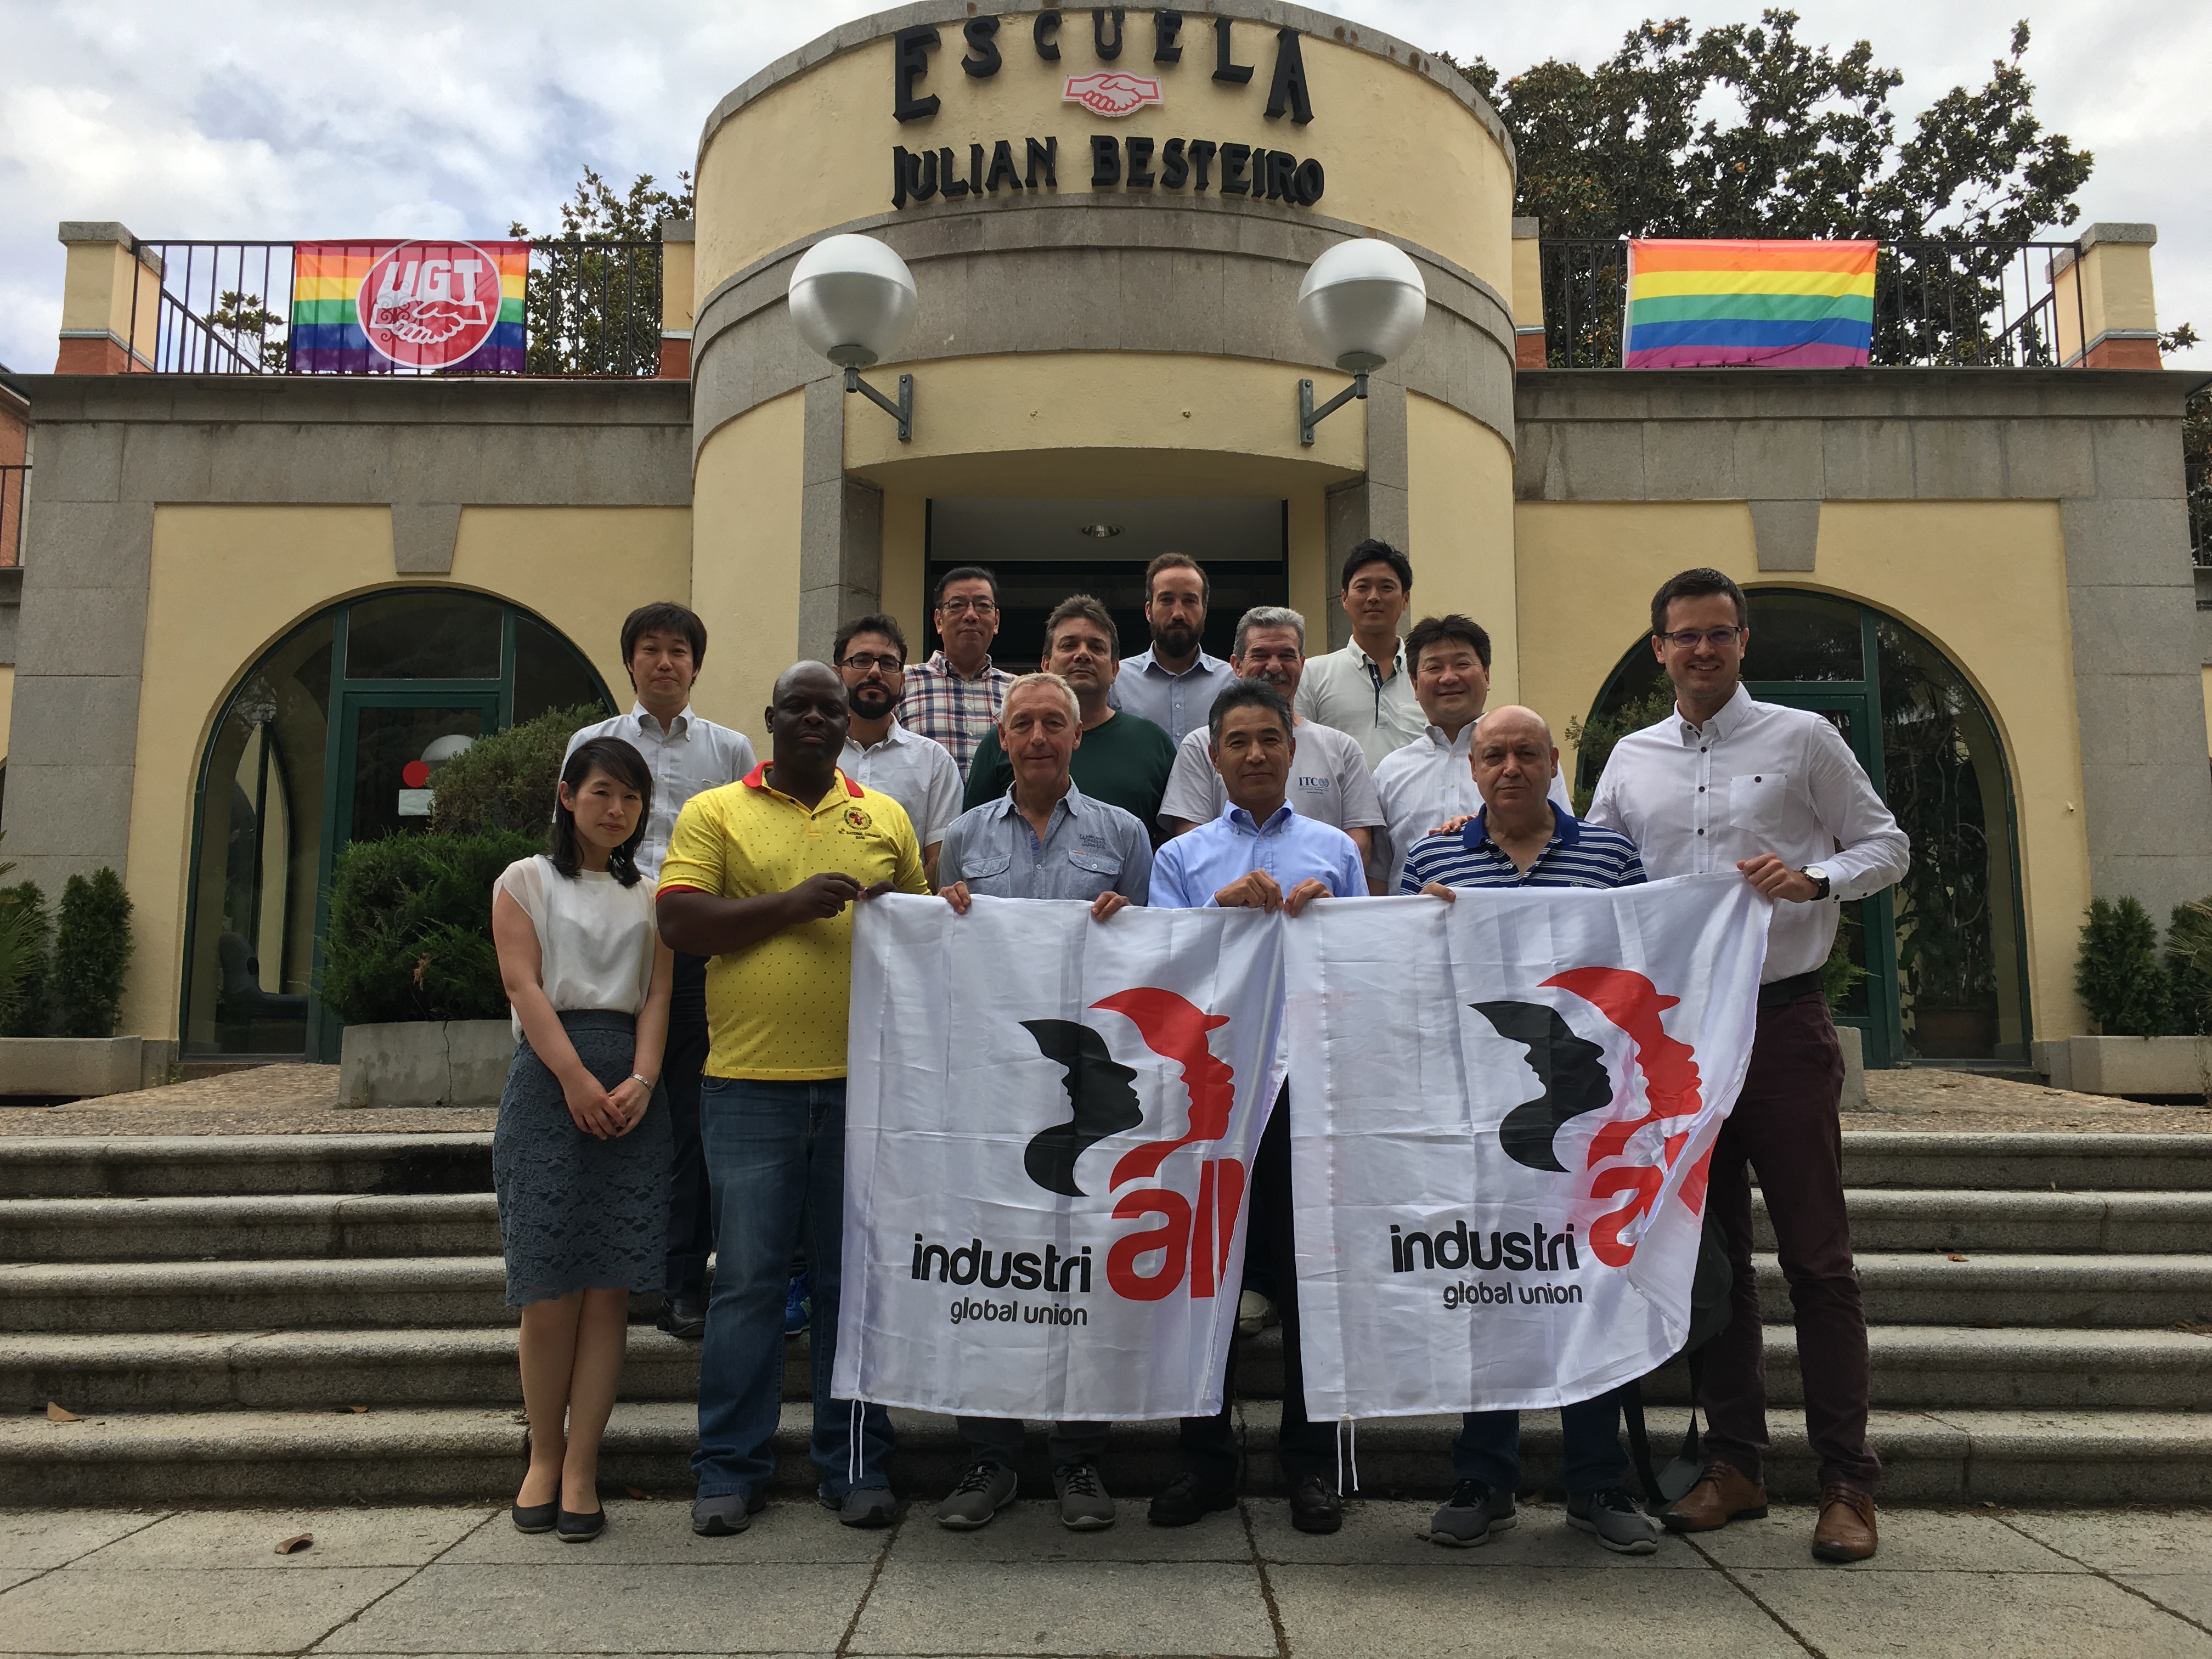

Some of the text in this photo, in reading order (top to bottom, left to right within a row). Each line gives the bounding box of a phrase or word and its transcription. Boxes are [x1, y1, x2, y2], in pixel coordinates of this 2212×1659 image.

[893, 10, 1314, 126] ESCUELA
[891, 134, 1325, 210] JULIAN BESTEIRO
[376, 259, 483, 306] UGT
[1299, 777, 1318, 786] ITC
[951, 1296, 1087, 1326] global union
[1443, 1280, 1582, 1310] global union
